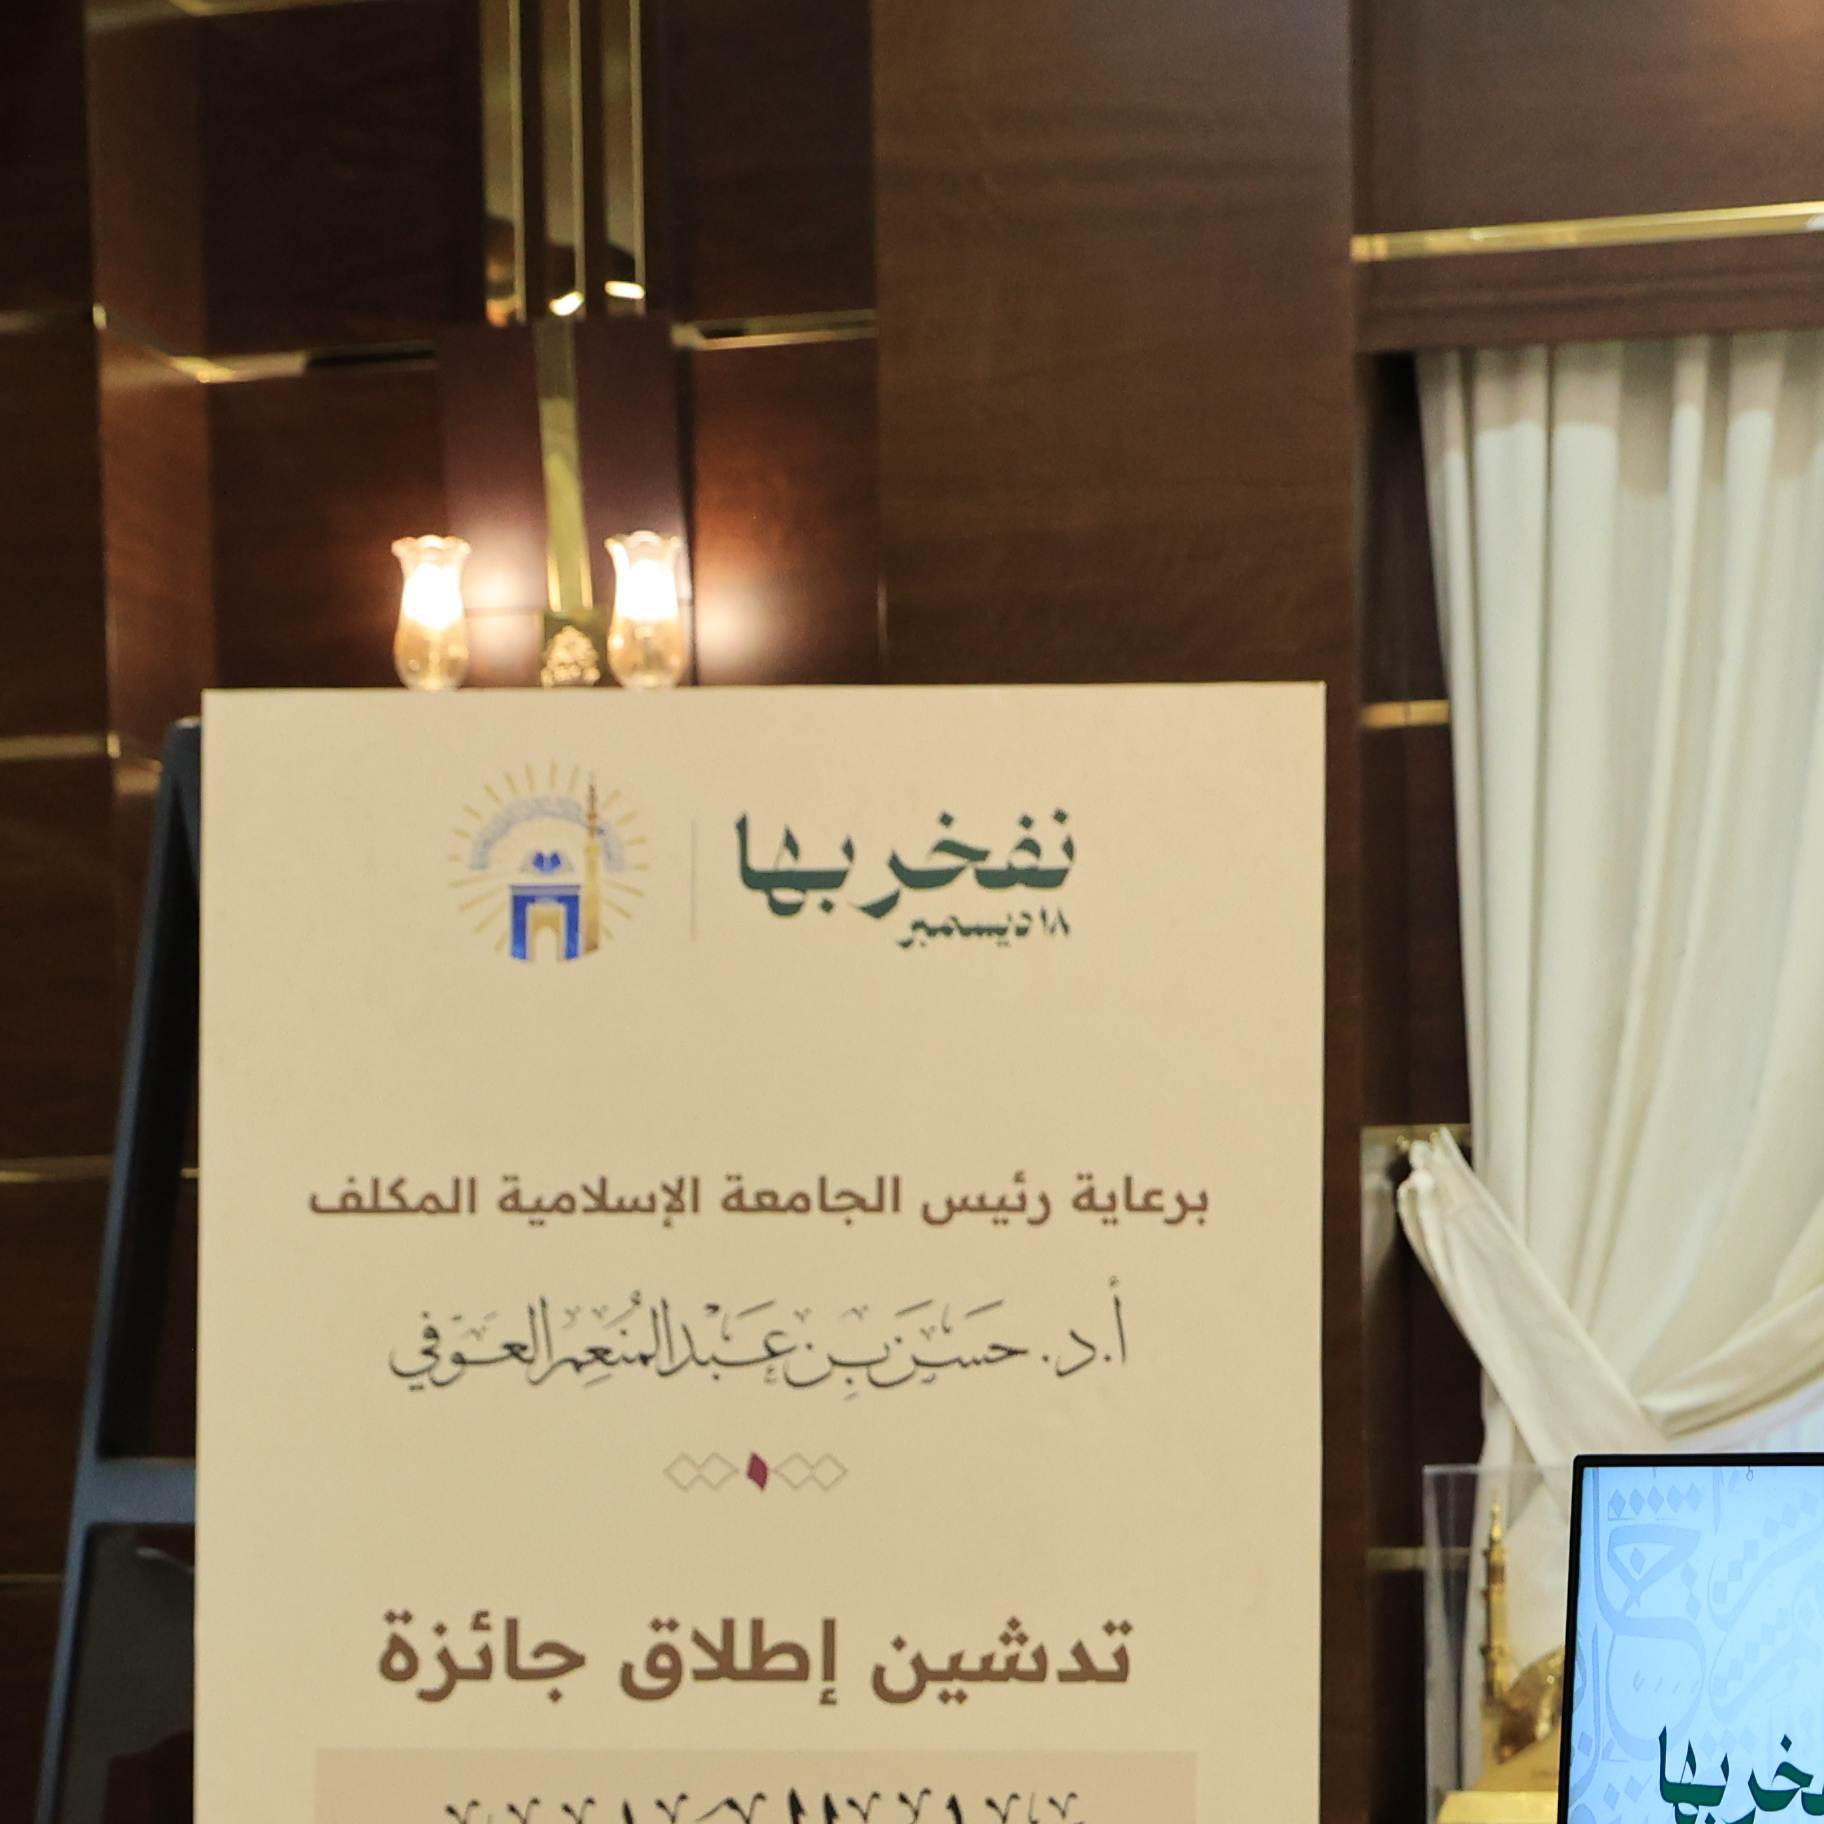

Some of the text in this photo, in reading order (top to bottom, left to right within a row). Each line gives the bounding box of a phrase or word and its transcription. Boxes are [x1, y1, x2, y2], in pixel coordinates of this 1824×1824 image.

[735, 812, 856, 918] بها
[848, 808, 1076, 920] نفخر
[896, 911, 1035, 949] ديسمبر
[308, 1171, 1209, 1229] برعاية رئيس الجامعة الإسلامية المكلف
[378, 1608, 1134, 1707] تدشين إطلاق جائزة
